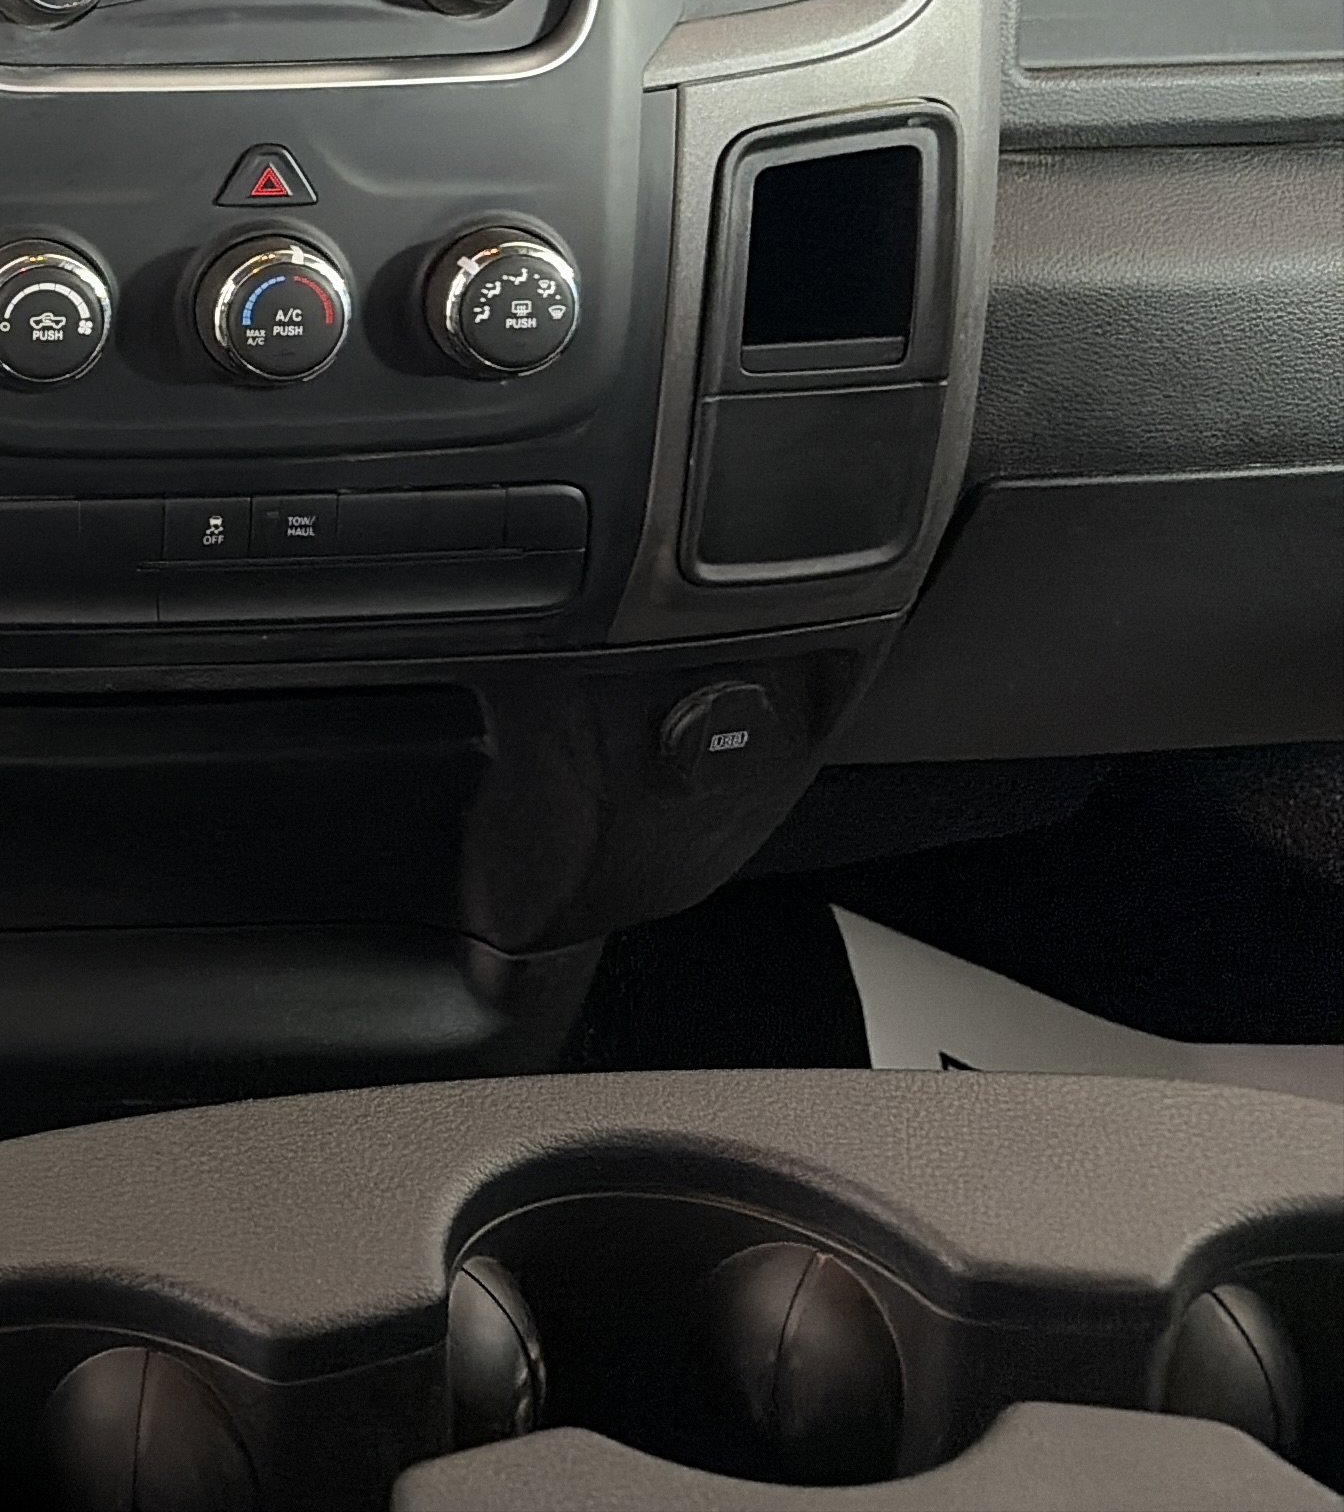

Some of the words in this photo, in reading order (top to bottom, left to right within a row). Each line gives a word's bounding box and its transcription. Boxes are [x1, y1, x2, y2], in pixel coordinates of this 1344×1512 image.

[275, 308, 303, 323] A/C
[506, 318, 537, 329] PUSH
[32, 330, 64, 341] PUSH
[272, 325, 304, 336] PUSH
[246, 338, 265, 346] A/C
[287, 526, 316, 536] HAUL
[202, 534, 225, 546] OFF
